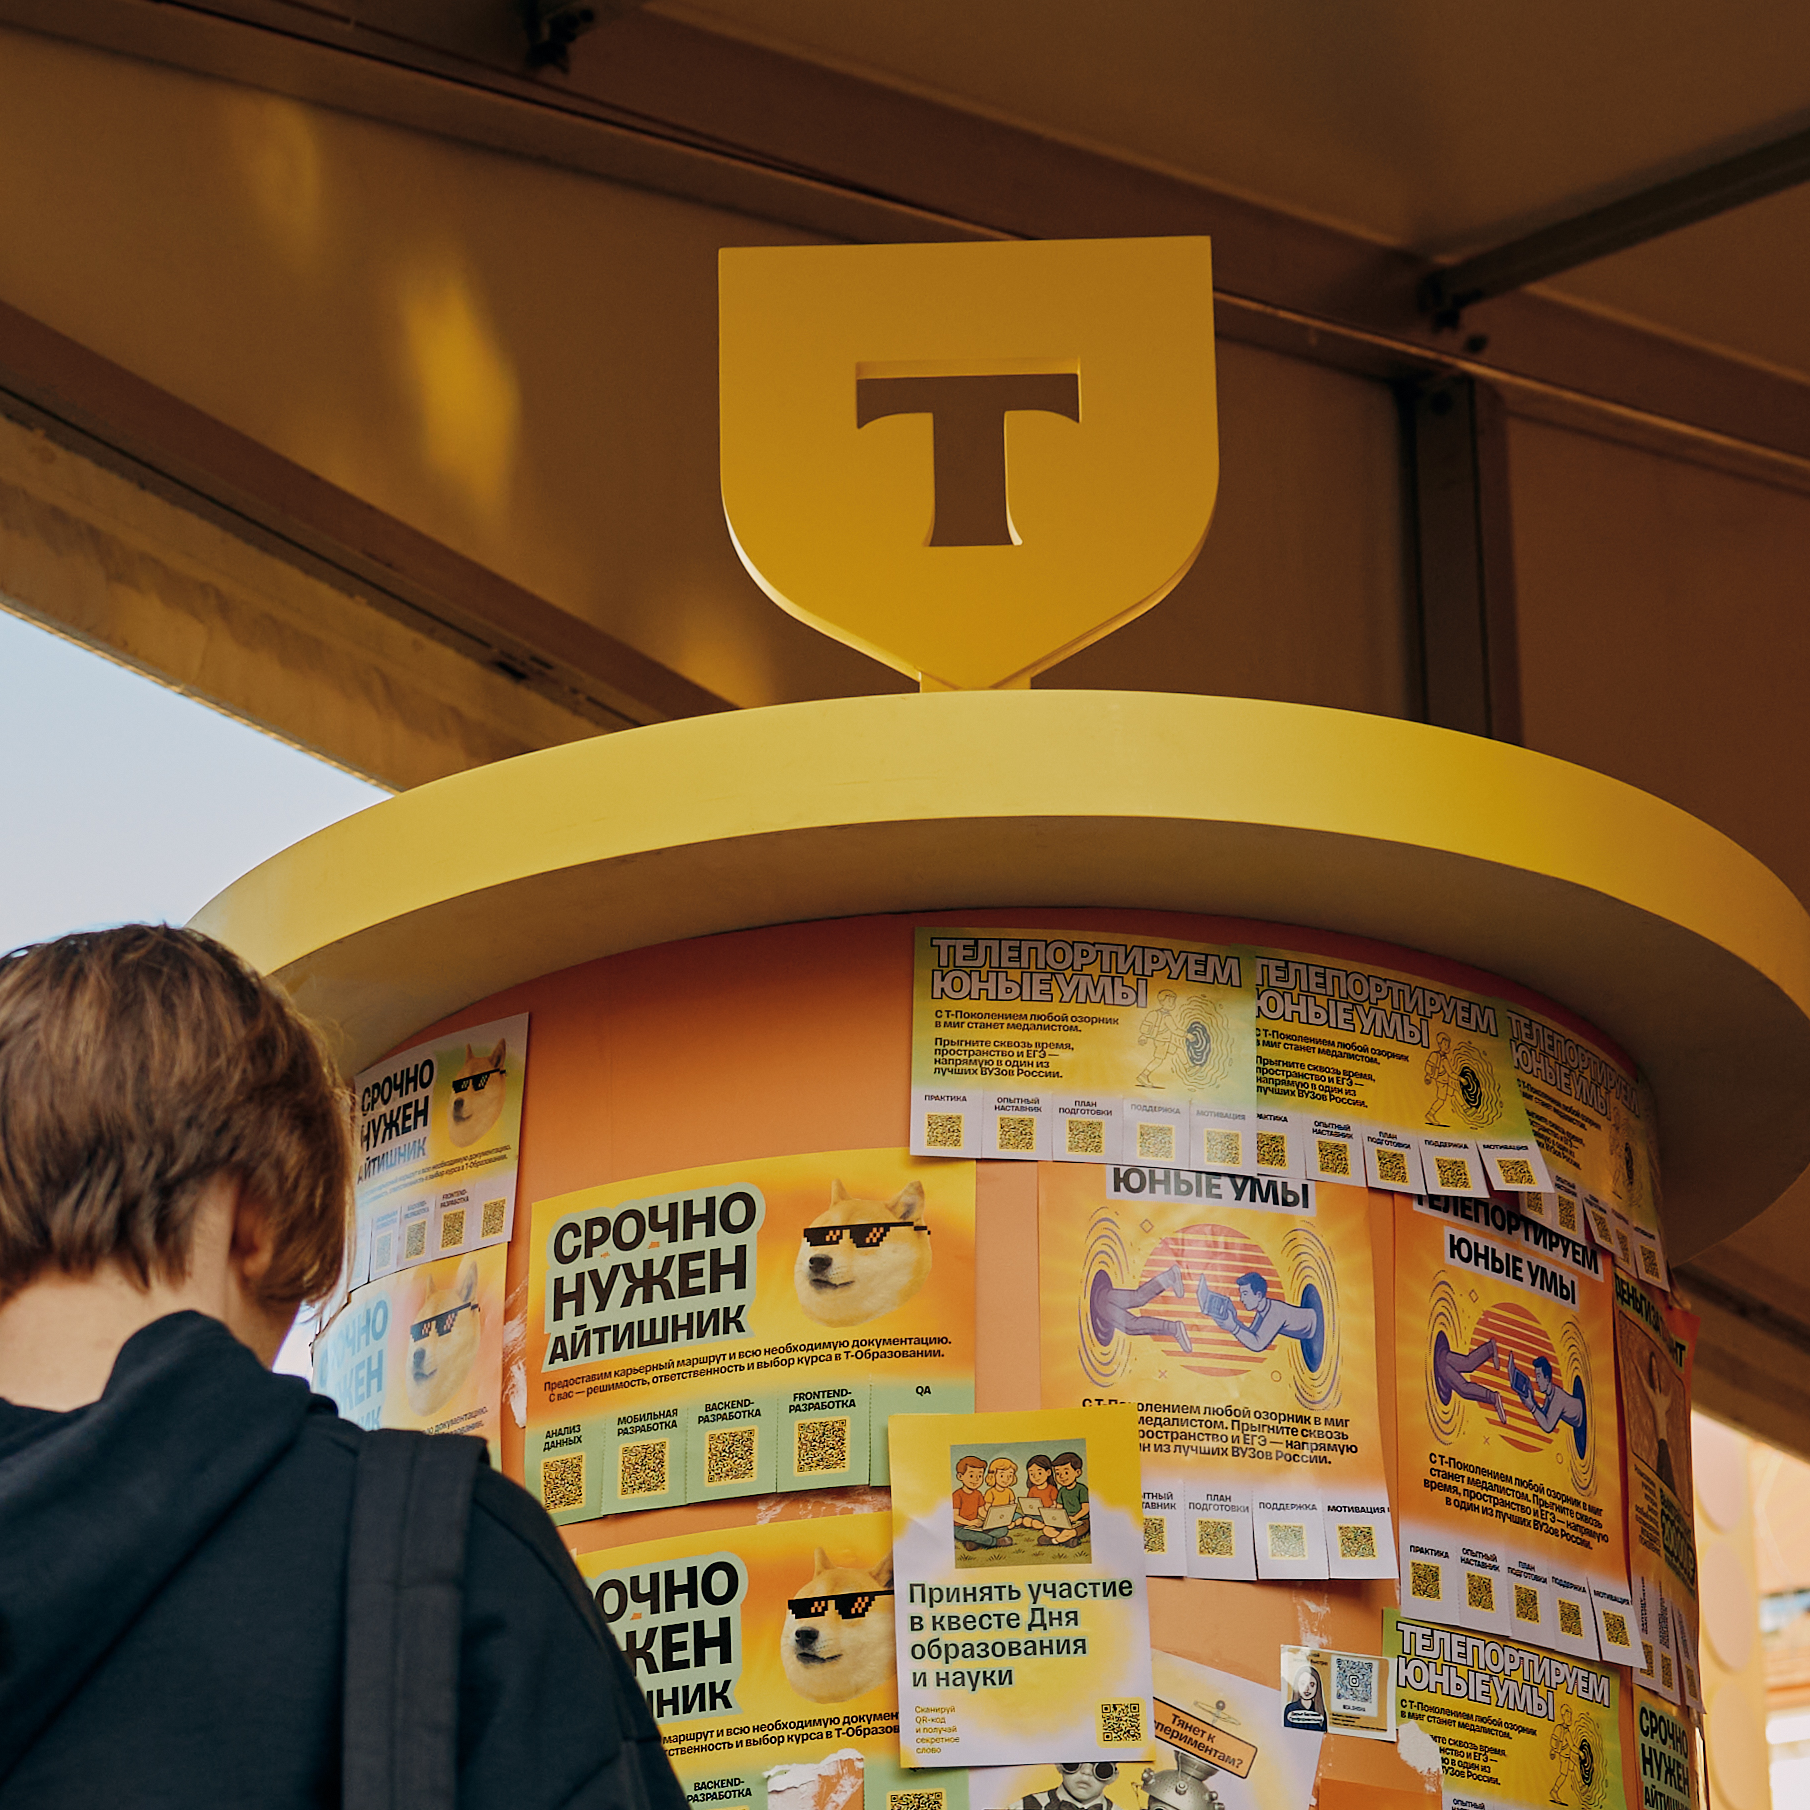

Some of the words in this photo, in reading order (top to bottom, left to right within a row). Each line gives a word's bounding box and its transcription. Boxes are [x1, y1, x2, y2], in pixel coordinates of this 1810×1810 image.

[931, 937, 1242, 988] ТЕЛЕПОРТИРУЕМ
[931, 969, 1053, 1003] ЮНЫЕ
[1059, 971, 1148, 1008] УМЫ
[944, 1022, 965, 1030] миг
[967, 1022, 1004, 1031] станет
[1006, 1022, 1082, 1032] медалистом.
[946, 1010, 1028, 1022] Т-Поколением
[1030, 1012, 1069, 1022] любой
[1071, 1015, 1119, 1025] озорник
[1357, 1012, 1430, 1049] УМЫ
[362, 1058, 434, 1117] СРОЧНО
[361, 1095, 429, 1152] НУЖЕН
[357, 1137, 428, 1185] АЙТИШНИК
[1113, 1166, 1221, 1199] ЮНЫЕ
[1229, 1174, 1310, 1211] УМЫ
[554, 1191, 757, 1265] СРОЧНО
[553, 1244, 747, 1322] НУЖЕН
[1449, 1234, 1525, 1285] ЮНЫЕ
[1528, 1263, 1577, 1305] УМЫ
[548, 1305, 746, 1366] АЙТИШНИК
[544, 1365, 612, 1393] Предоставим
[614, 1358, 675, 1379] карьерный
[676, 1352, 727, 1370] маршрут
[729, 1351, 736, 1360] и
[738, 1349, 761, 1361] всю
[764, 1339, 849, 1357] необходимую
[852, 1334, 952, 1350] документацию.
[558, 1391, 575, 1401] вас
[586, 1379, 650, 1397] решимость,
[652, 1364, 744, 1385] ответственность
[757, 1355, 797, 1370] выбор
[799, 1352, 833, 1367] курса
[844, 1347, 945, 1361] Т-Образовании.
[793, 1389, 852, 1402] FRONTEND-
[916, 1386, 931, 1396] QA
[617, 1409, 679, 1426] МОБИЛЬНАЯ
[698, 1409, 761, 1424] РАЗРАБОТКА
[705, 1399, 755, 1413] BACKEND-
[788, 1400, 856, 1413] РАЗРАБОТКА
[543, 1434, 583, 1452] ДАННЫХ
[545, 1424, 581, 1439] АНАЛИЗ
[617, 1420, 678, 1437] РАЗРАБОТКА
[909, 1582, 1022, 1608] Принять
[1028, 1579, 1133, 1603] участие
[910, 1615, 924, 1631] в
[932, 1611, 1021, 1631] квесте
[1028, 1608, 1079, 1631] Дня
[911, 1638, 1087, 1664] образования
[1396, 1621, 1611, 1708] ТЕЛЕПОРТИРУЕМ
[913, 1672, 927, 1687] и
[936, 1668, 1014, 1691] науки
[1396, 1657, 1491, 1705] ЮНЫЕ
[1491, 1677, 1555, 1721] УМЫ
[915, 1705, 956, 1715] Сканируй
[915, 1716, 946, 1724] QR-код
[921, 1725, 957, 1735] получай
[1640, 1706, 1689, 1758] СРОЧНО
[1640, 1743, 1690, 1798] НУЖЕН
